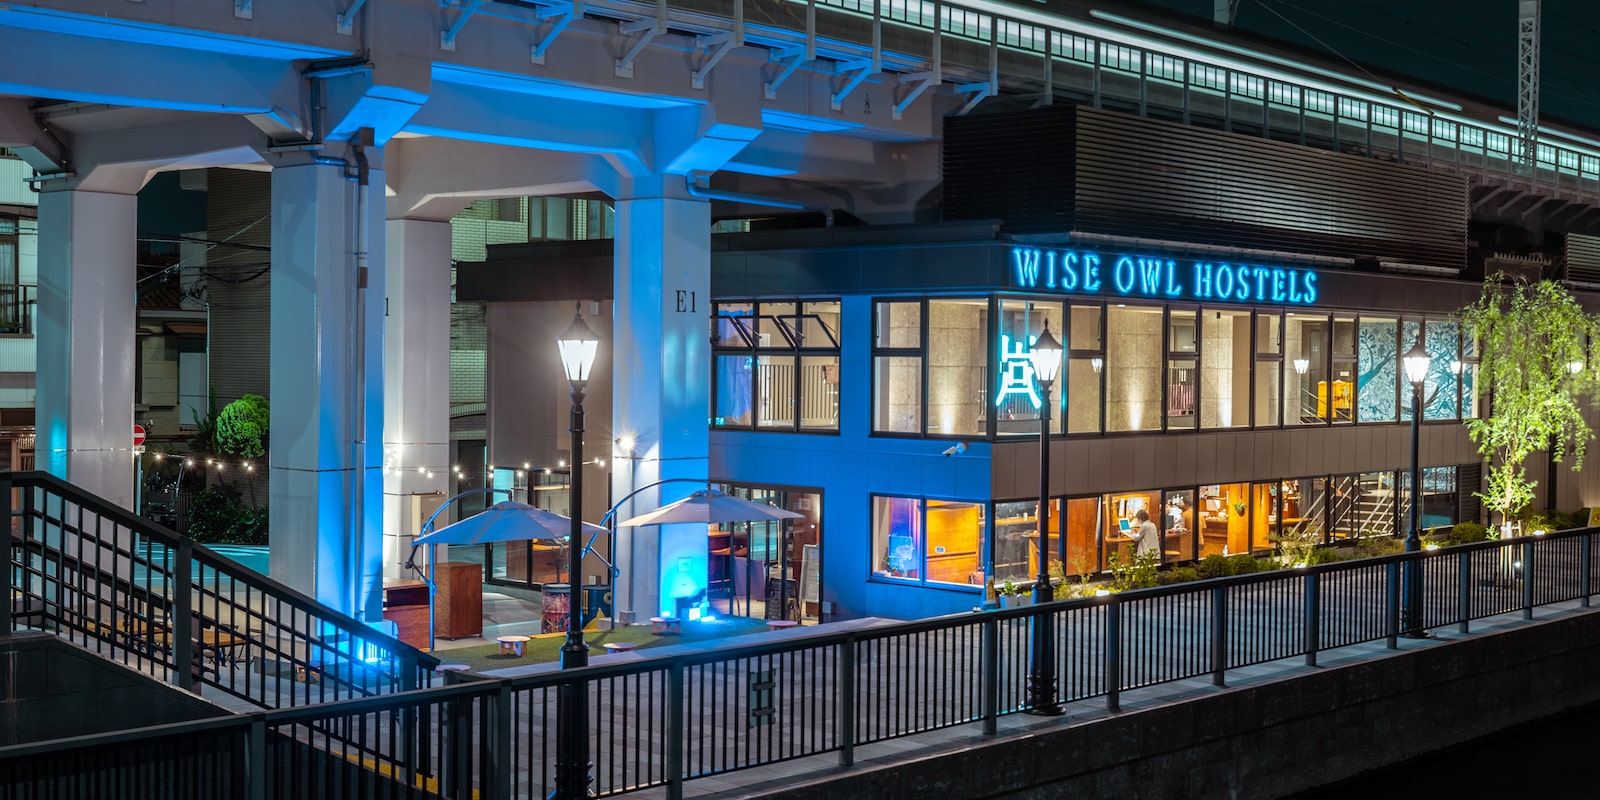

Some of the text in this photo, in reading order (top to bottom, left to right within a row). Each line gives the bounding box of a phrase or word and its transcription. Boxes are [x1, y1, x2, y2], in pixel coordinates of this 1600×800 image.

[1013, 247, 1317, 303] WISE OWL HOSTELS
[675, 289, 697, 313] E1
